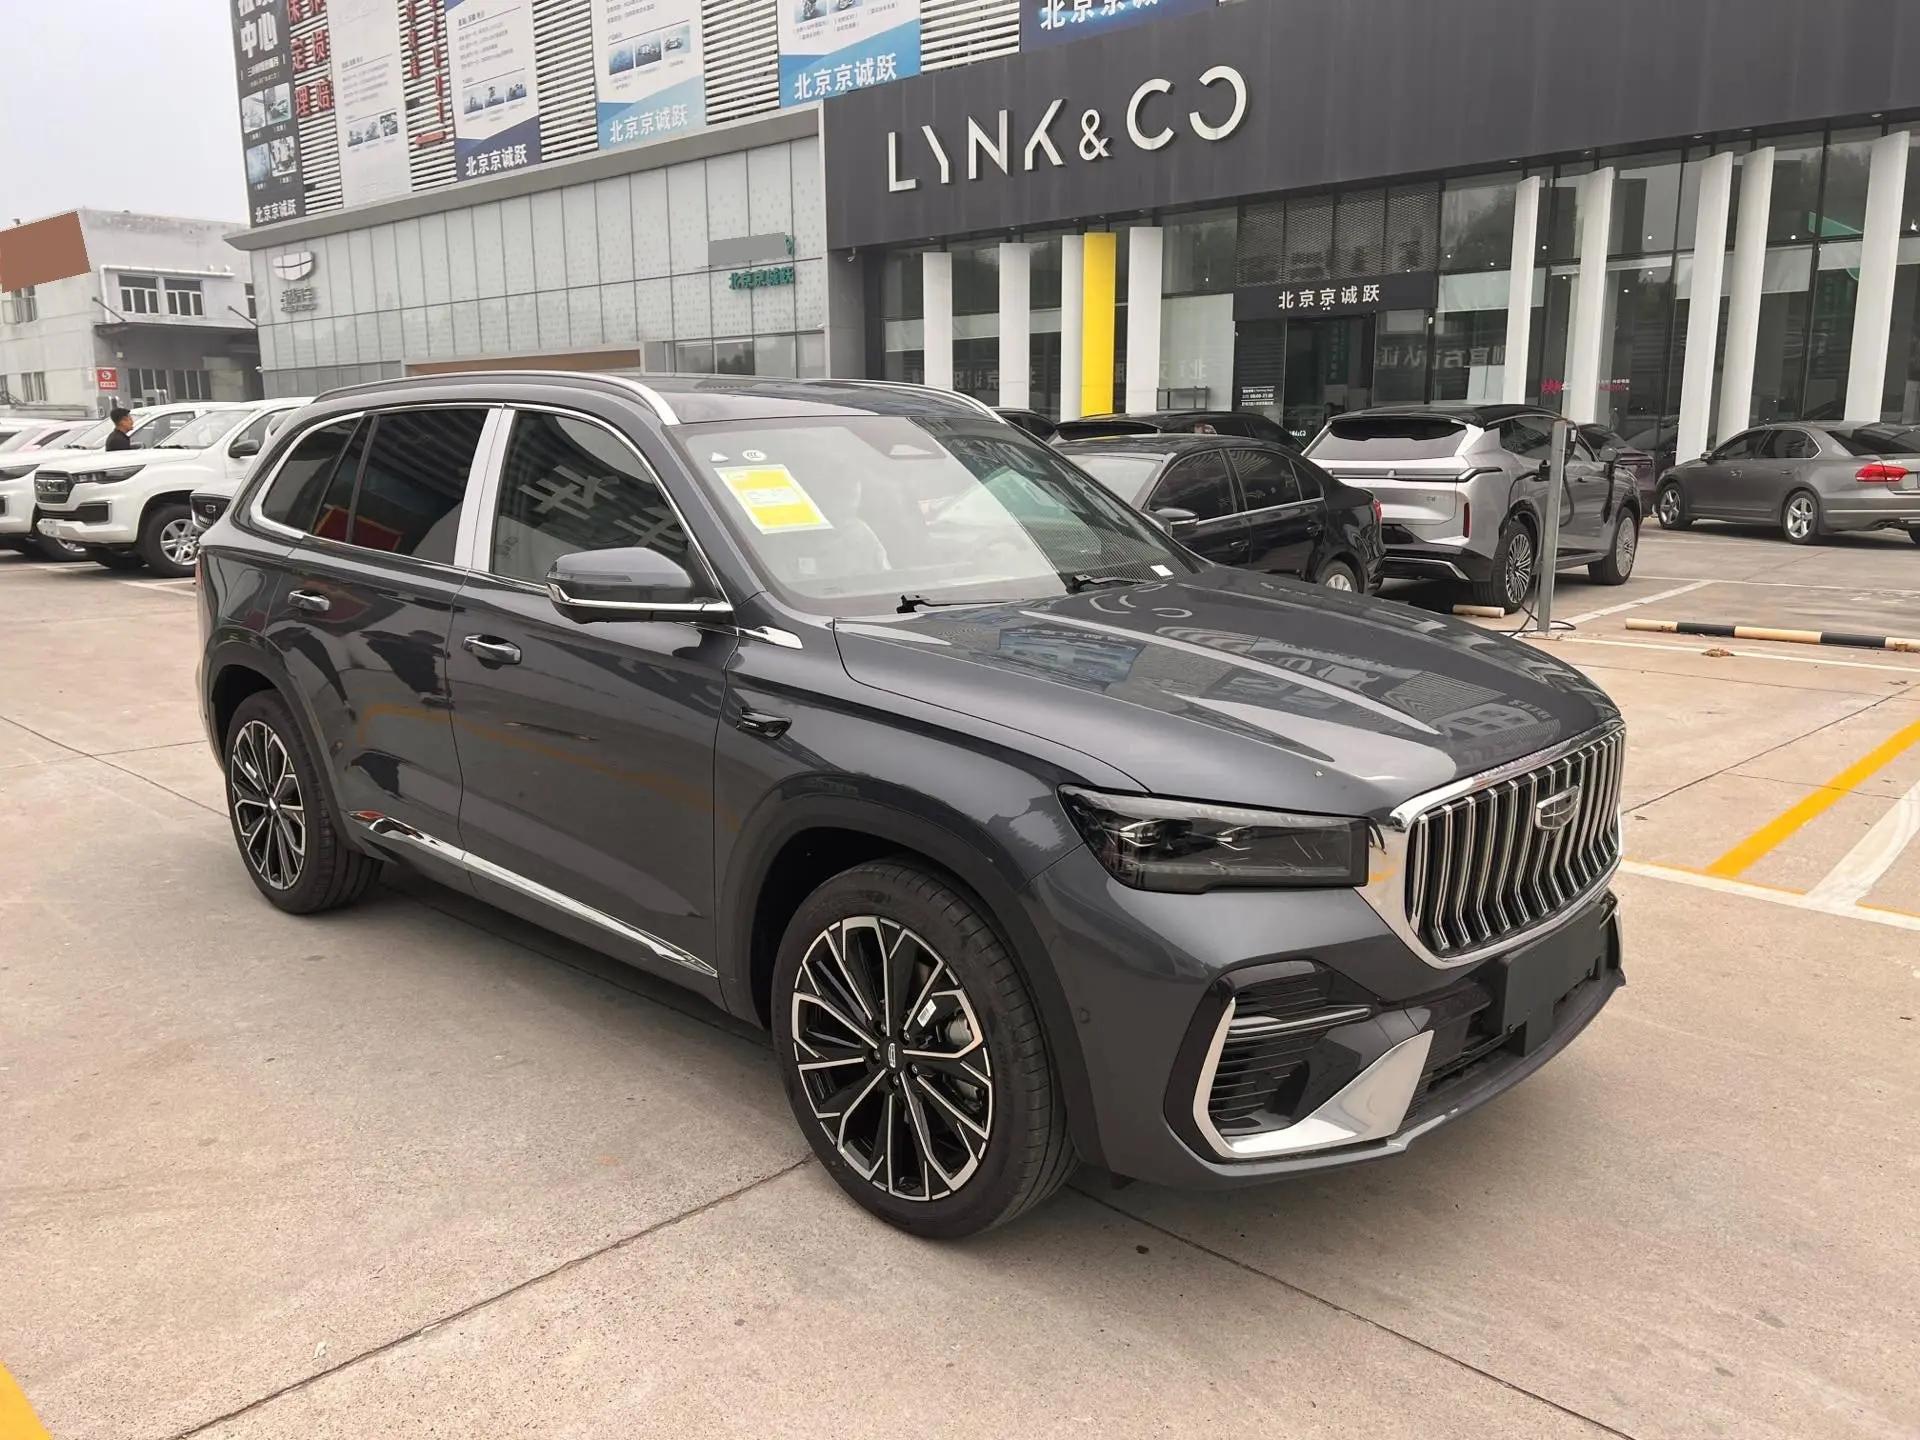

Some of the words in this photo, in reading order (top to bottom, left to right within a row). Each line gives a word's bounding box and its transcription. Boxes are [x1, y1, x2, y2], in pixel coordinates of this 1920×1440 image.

[240, 12, 278, 58] 中心
[794, 53, 897, 100] 北京京诚跃
[610, 104, 688, 144] 北京京诚跃
[465, 144, 528, 177] 北京京诚跃
[1278, 284, 1380, 310] 北京京诚跃
